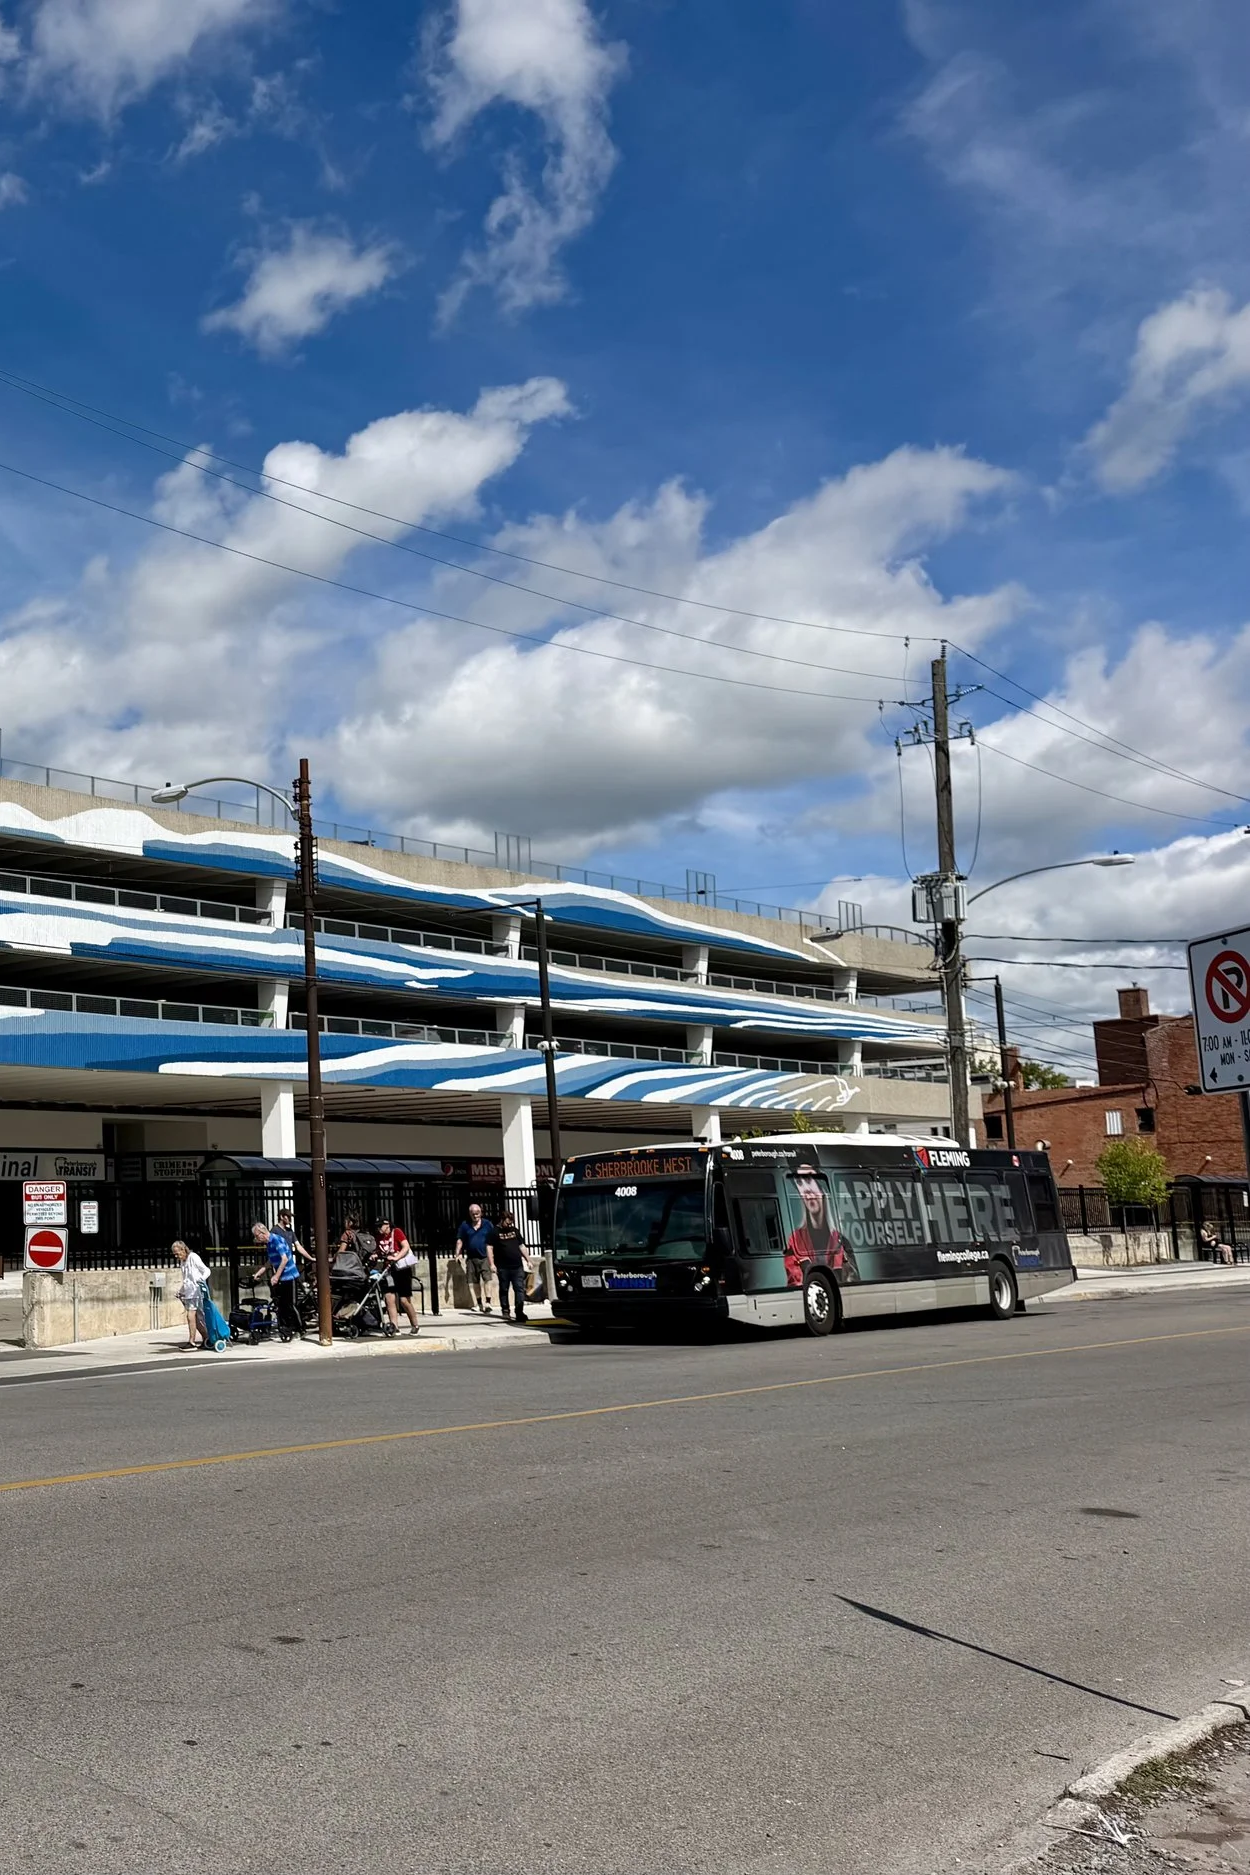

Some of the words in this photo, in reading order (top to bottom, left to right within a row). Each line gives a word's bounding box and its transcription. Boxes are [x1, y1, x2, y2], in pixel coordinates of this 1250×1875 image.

[1202, 1035, 1219, 1052] 7:00
[1223, 1036, 1232, 1049] AM
[1220, 1052, 1235, 1065] MON
[63, 1160, 98, 1168] Peterborough
[153, 1161, 182, 1169] CRIME
[928, 1150, 971, 1167] FLEMING
[58, 1166, 97, 1177] TRANSIT
[585, 1163, 592, 1179] 6
[595, 1159, 660, 1178] SHERBROOKE
[663, 1156, 692, 1174] WEST
[615, 1186, 637, 1197] 4008
[838, 1181, 914, 1220] APPLY
[914, 1182, 1021, 1245] HERE
[842, 1220, 924, 1246] YOURSELF
[936, 1249, 990, 1263] flemingcollege.ca
[613, 1271, 658, 1280] Peterborough
[607, 1279, 657, 1289] TRANSIT
